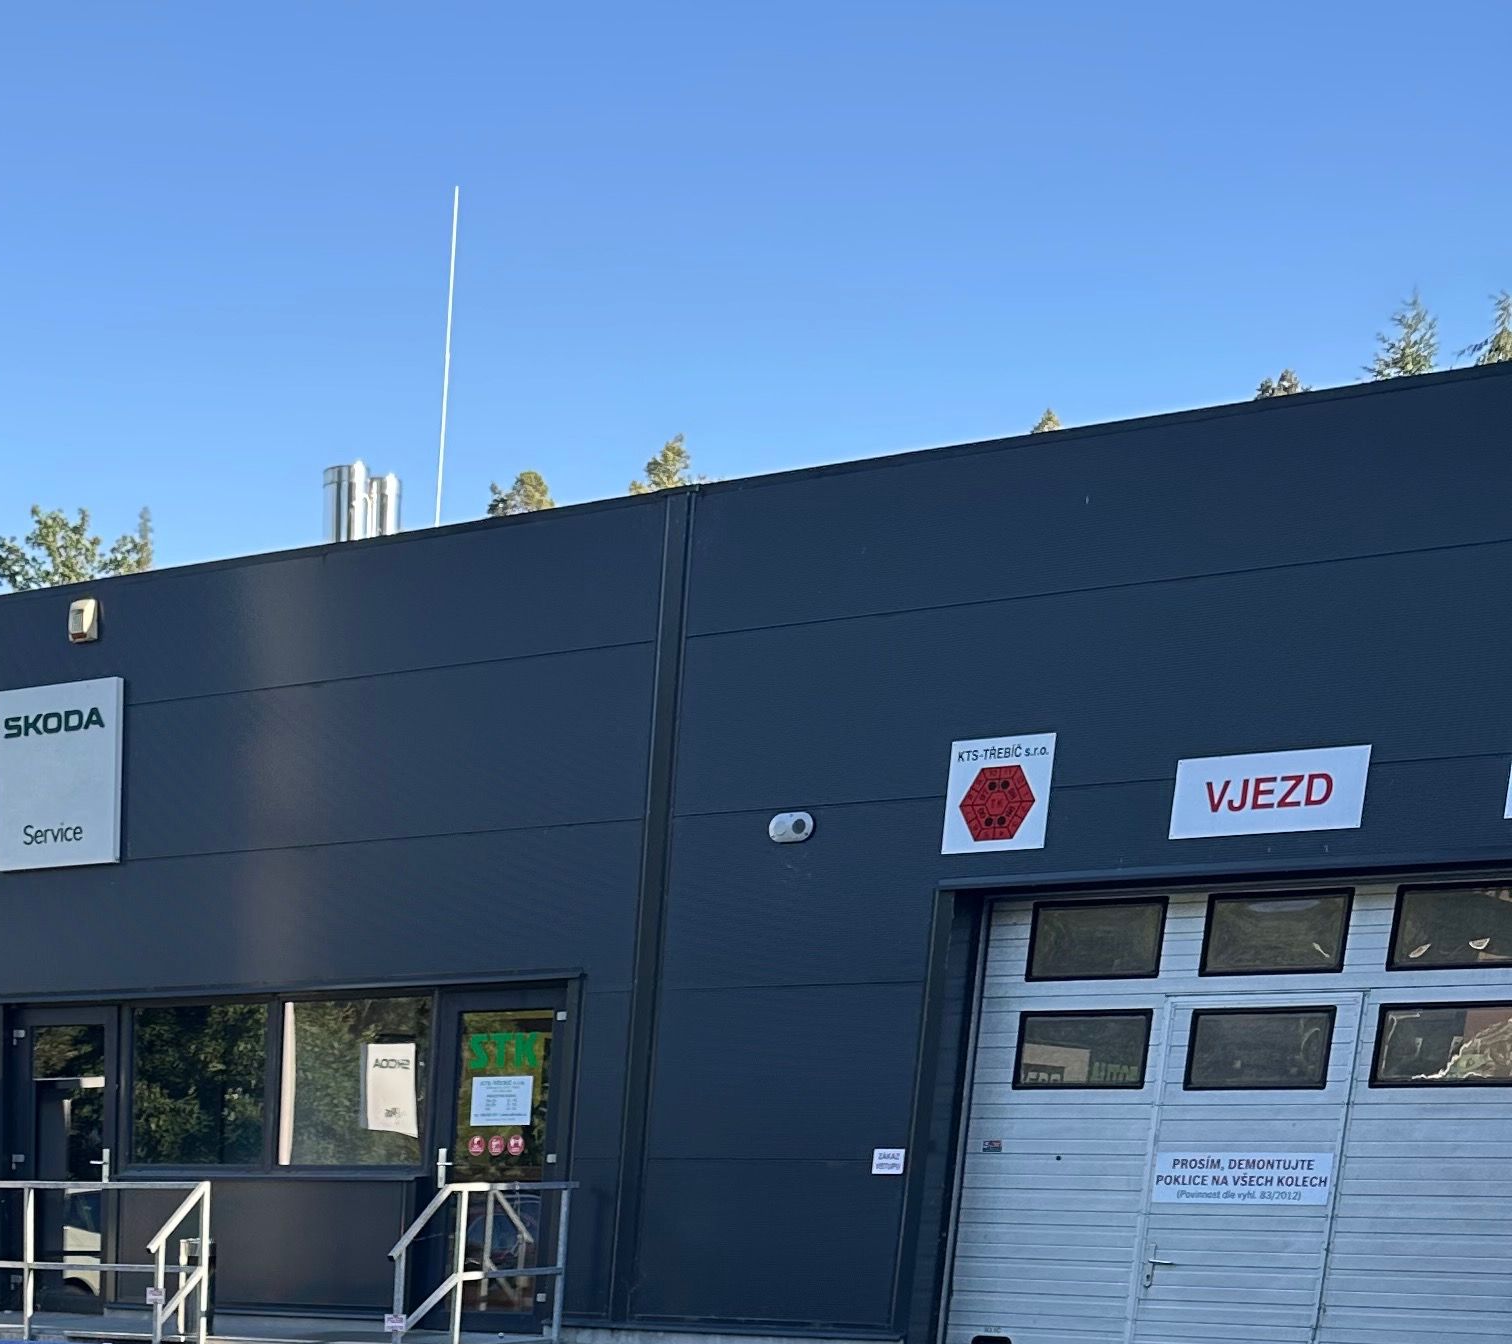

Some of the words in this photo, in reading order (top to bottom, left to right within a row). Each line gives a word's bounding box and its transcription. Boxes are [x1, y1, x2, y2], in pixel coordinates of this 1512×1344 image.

[4, 707, 105, 739] SKODA
[957, 743, 1023, 763] KTS-TŘEBÍČ
[1024, 746, 1049, 757] s.r.o.
[1205, 773, 1334, 813] VJEZD
[23, 823, 83, 846] Service
[470, 1032, 537, 1069] STK
[1171, 1155, 1225, 1171] PROSÍM,
[1228, 1158, 1315, 1171] DEMONTUJTE
[1155, 1174, 1208, 1186] POKLICE
[1211, 1175, 1229, 1187] NA
[1232, 1172, 1273, 1187] VŠECH
[1276, 1175, 1329, 1188] KOLECH
